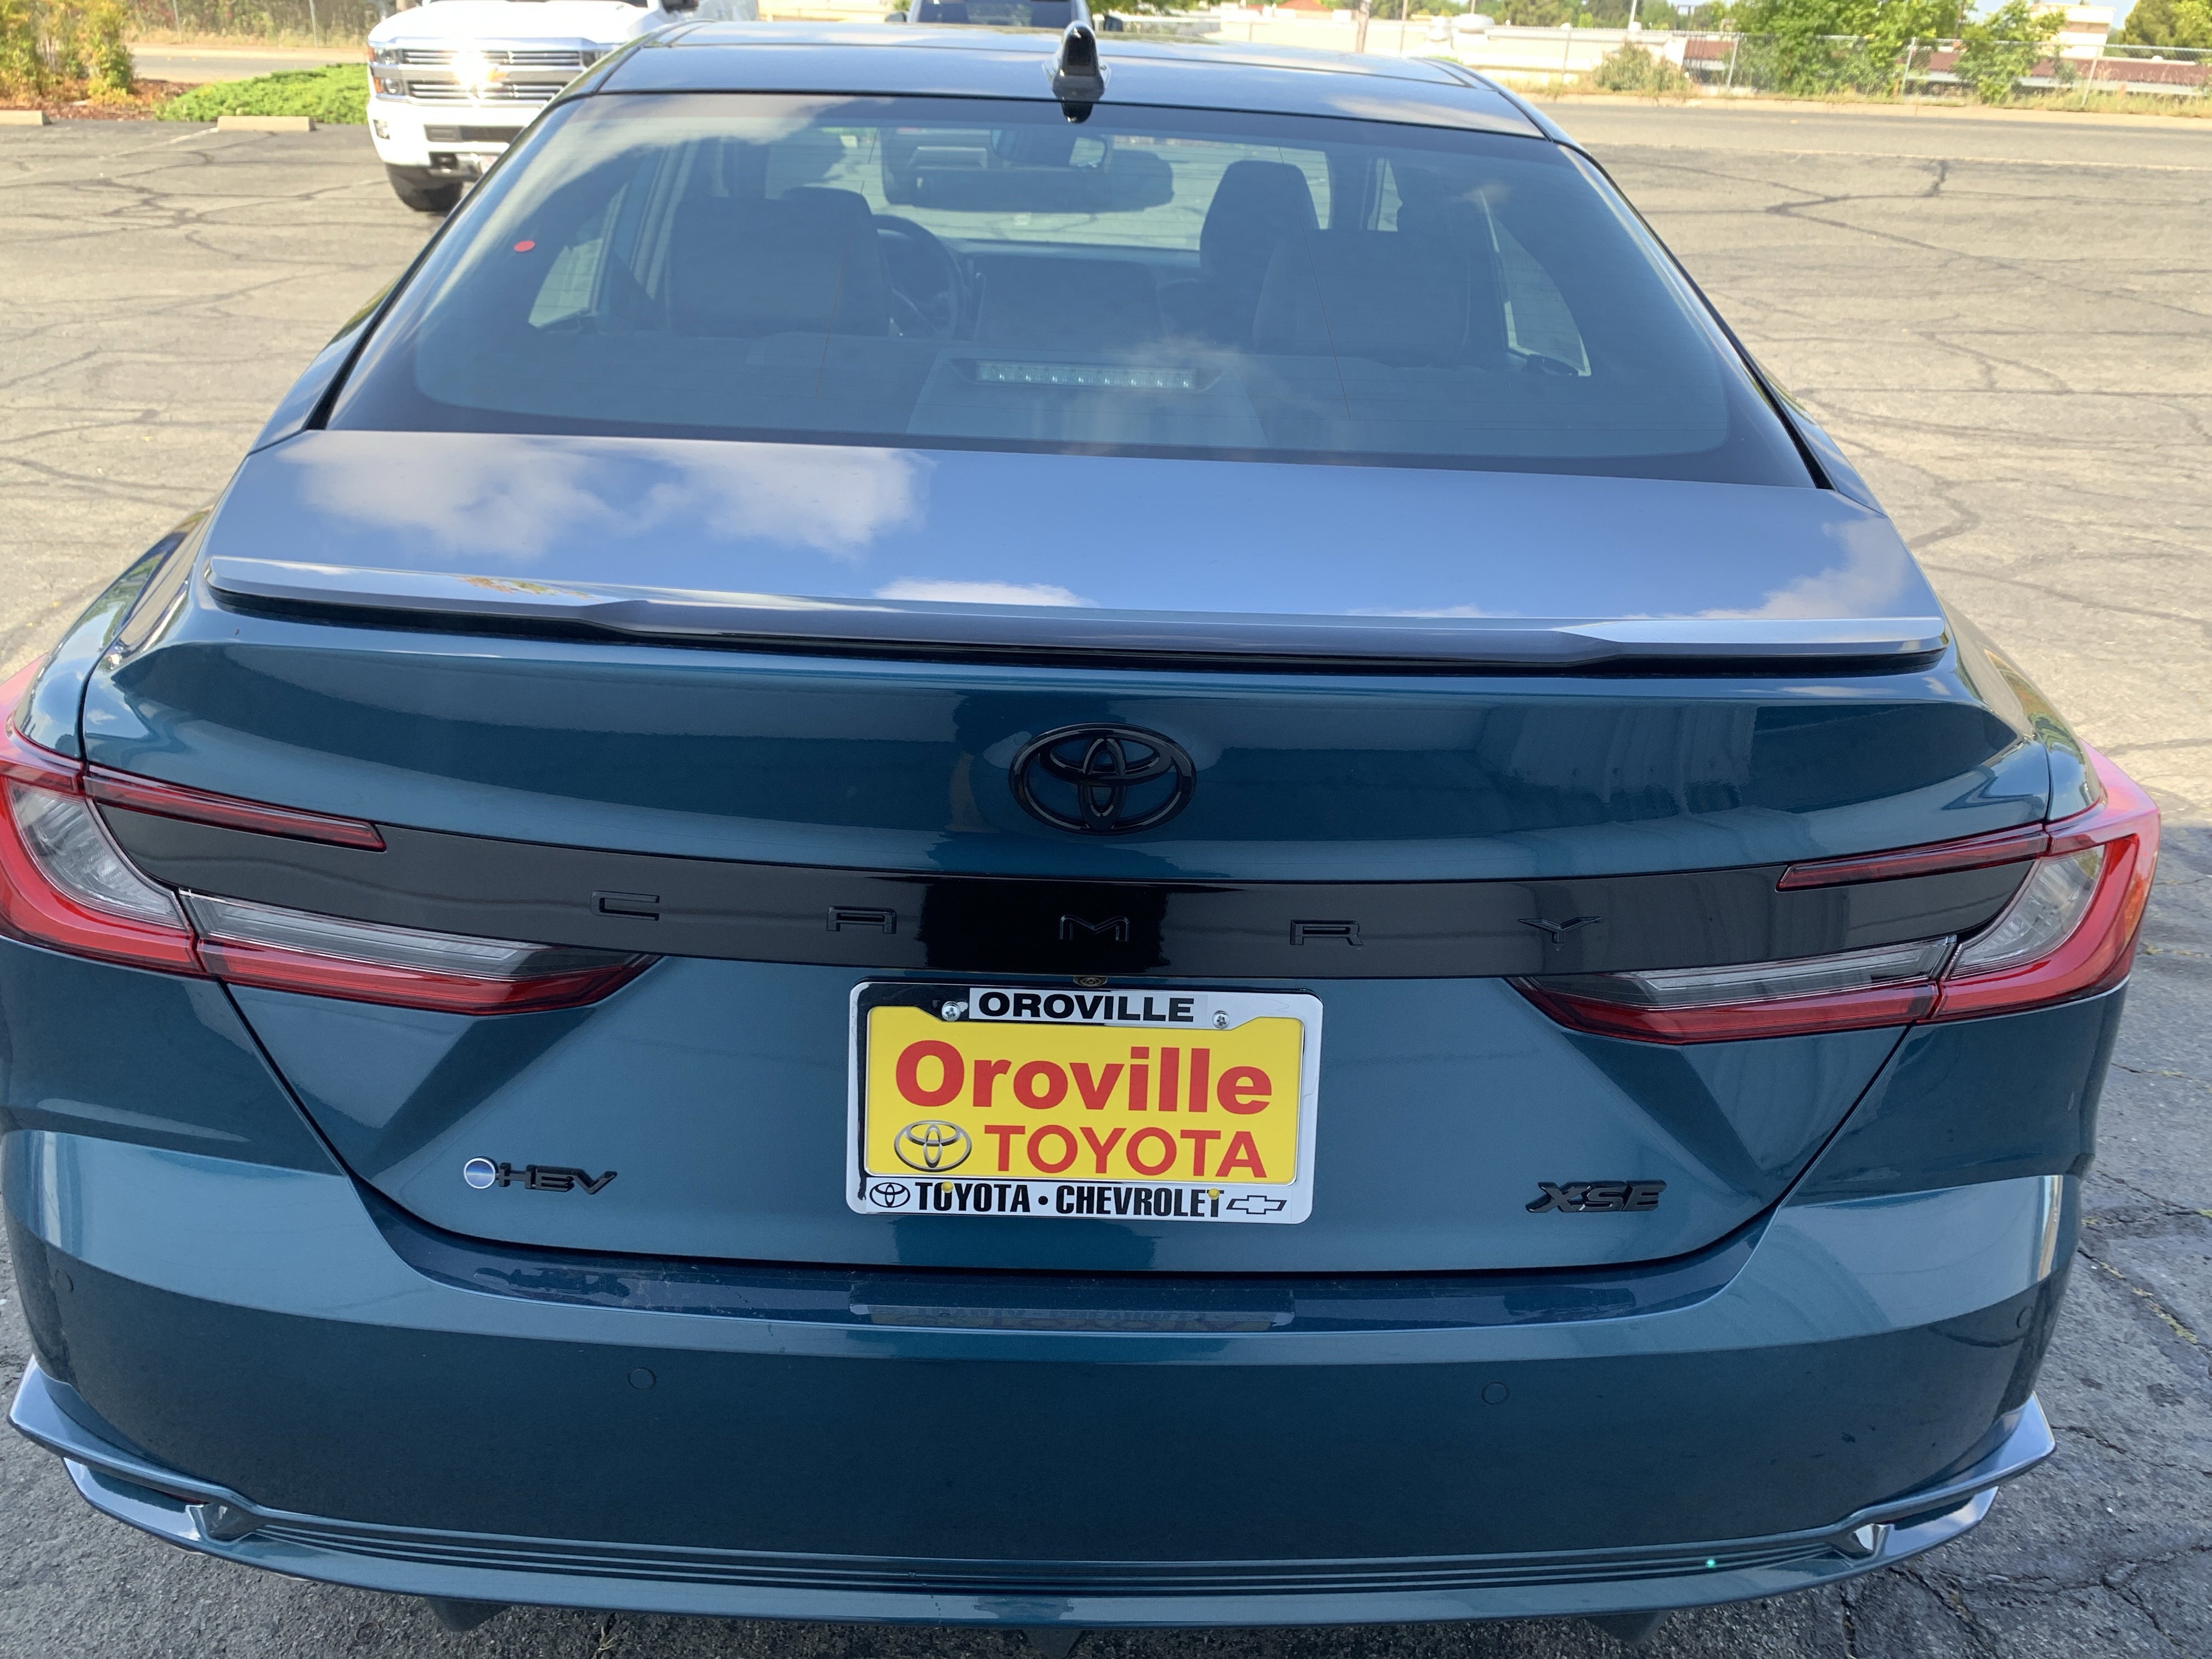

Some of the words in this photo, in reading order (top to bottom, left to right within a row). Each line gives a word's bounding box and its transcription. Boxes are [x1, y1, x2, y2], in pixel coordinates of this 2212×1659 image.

[590, 889, 1602, 946] CAMRY
[978, 991, 1195, 1023] OROVILLE
[895, 1040, 1272, 1116] Oroville
[984, 1124, 1268, 1178] TOYOTA
[915, 1181, 1031, 1213] TOYOTA
[1056, 1187, 1224, 1217] CHEVROLET
[1525, 1180, 1667, 1213] XSE
